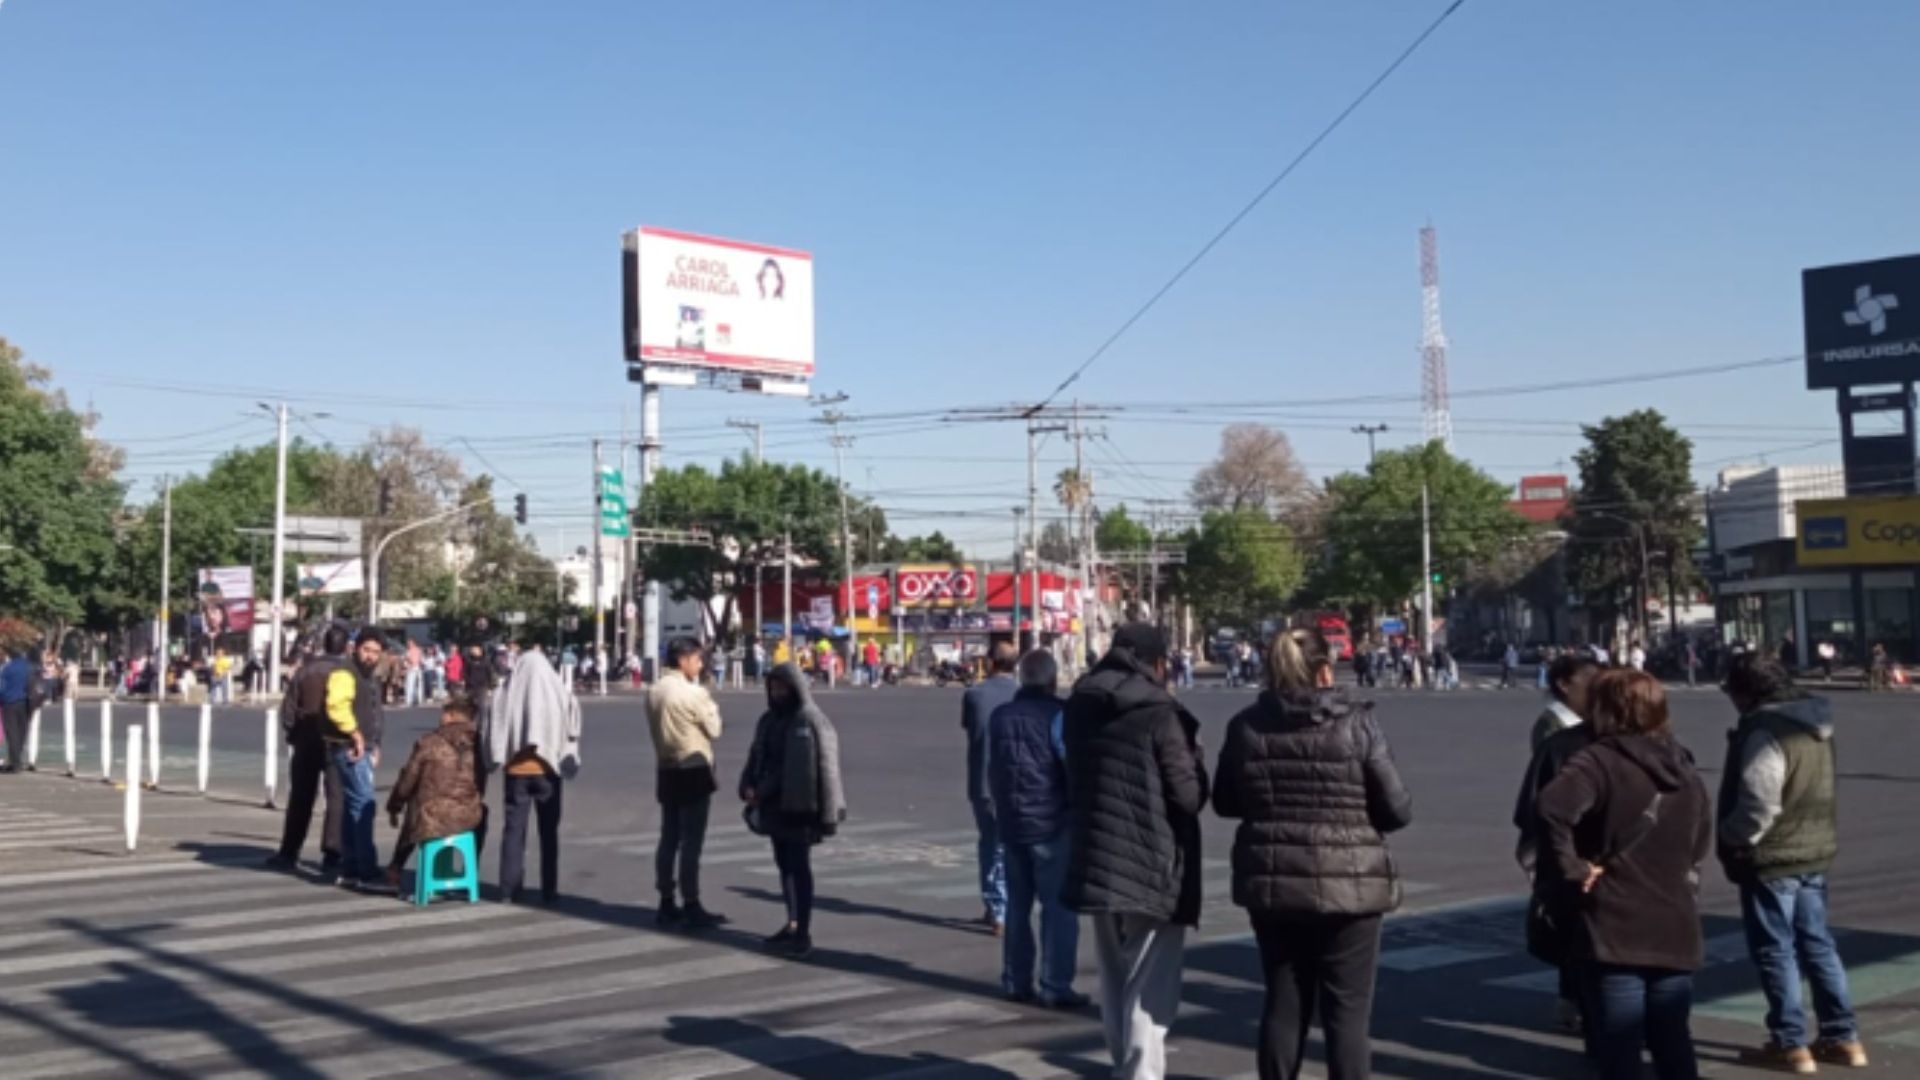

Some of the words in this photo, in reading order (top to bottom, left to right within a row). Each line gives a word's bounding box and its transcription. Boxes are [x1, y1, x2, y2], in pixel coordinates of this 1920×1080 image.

[674, 254, 730, 278] CAROL
[666, 271, 740, 296] ARRIAGA
[902, 573, 972, 597] OXXO
